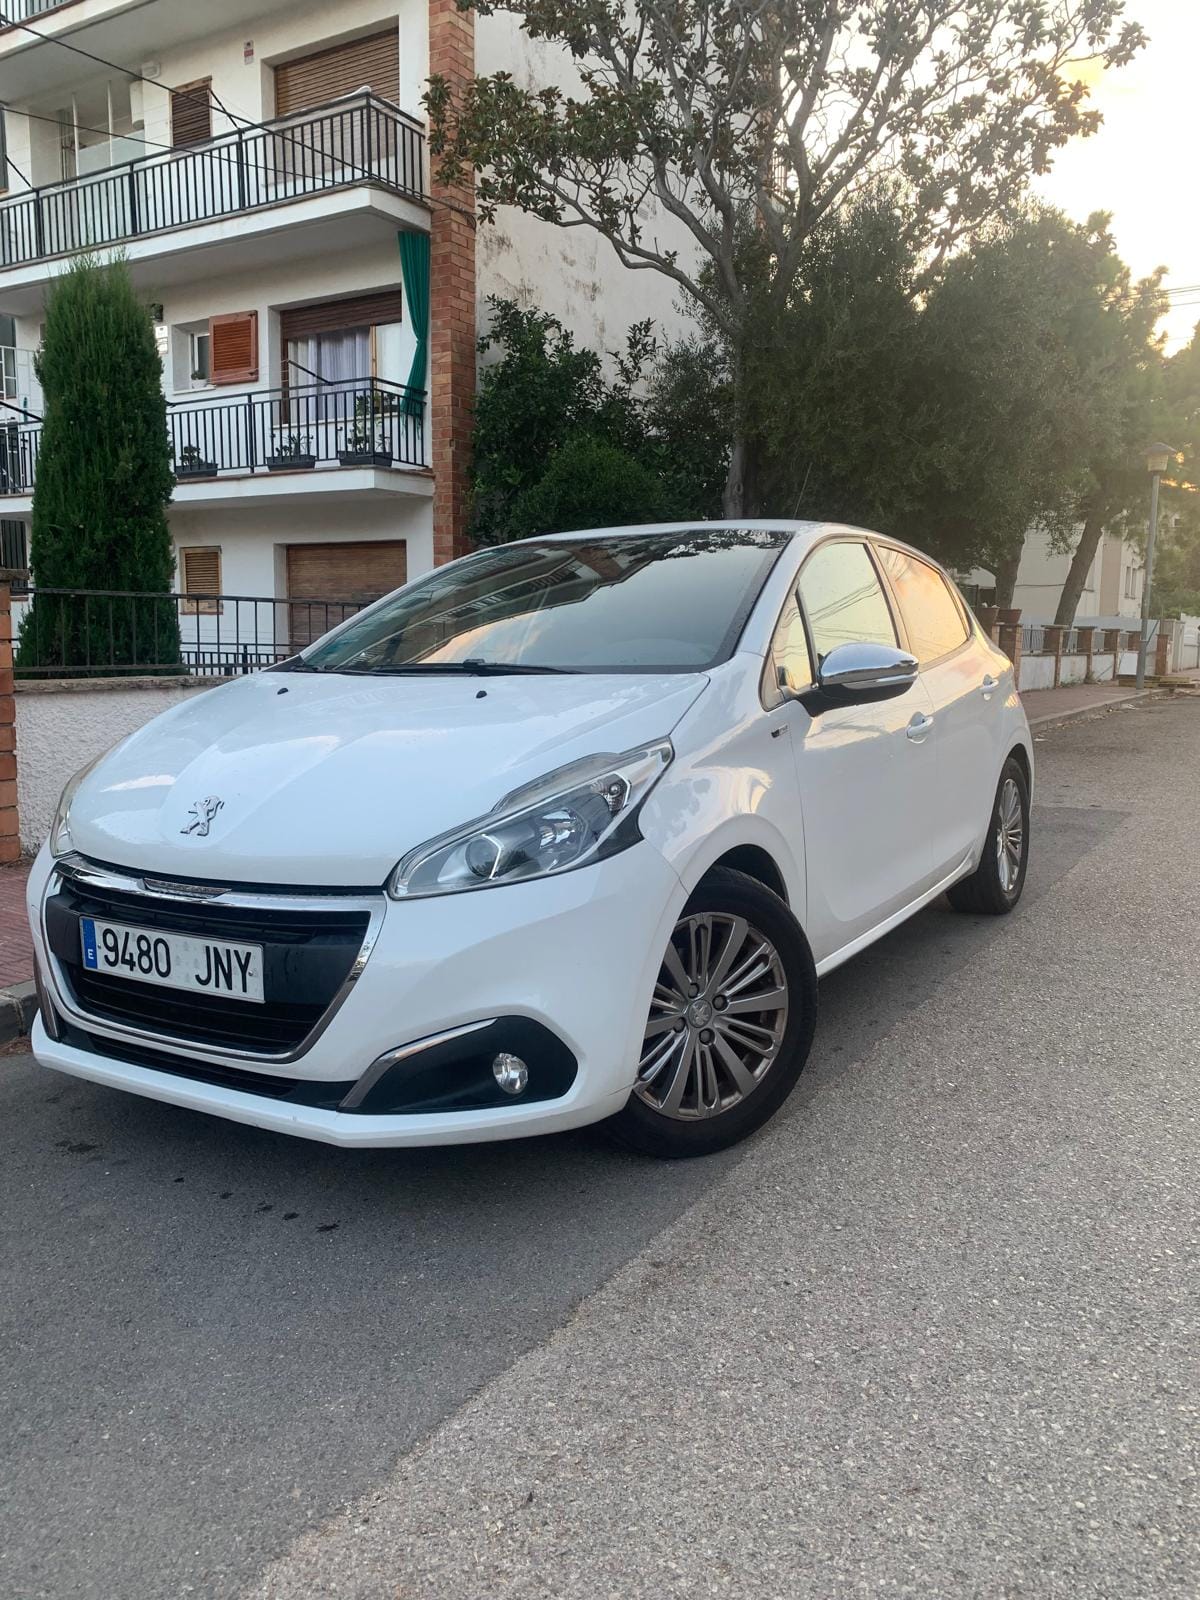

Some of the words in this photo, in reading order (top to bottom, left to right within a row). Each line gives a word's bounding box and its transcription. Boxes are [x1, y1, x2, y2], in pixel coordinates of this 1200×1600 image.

[88, 949, 95, 960] E
[103, 928, 171, 977] 9480
[196, 946, 251, 992] JNY
